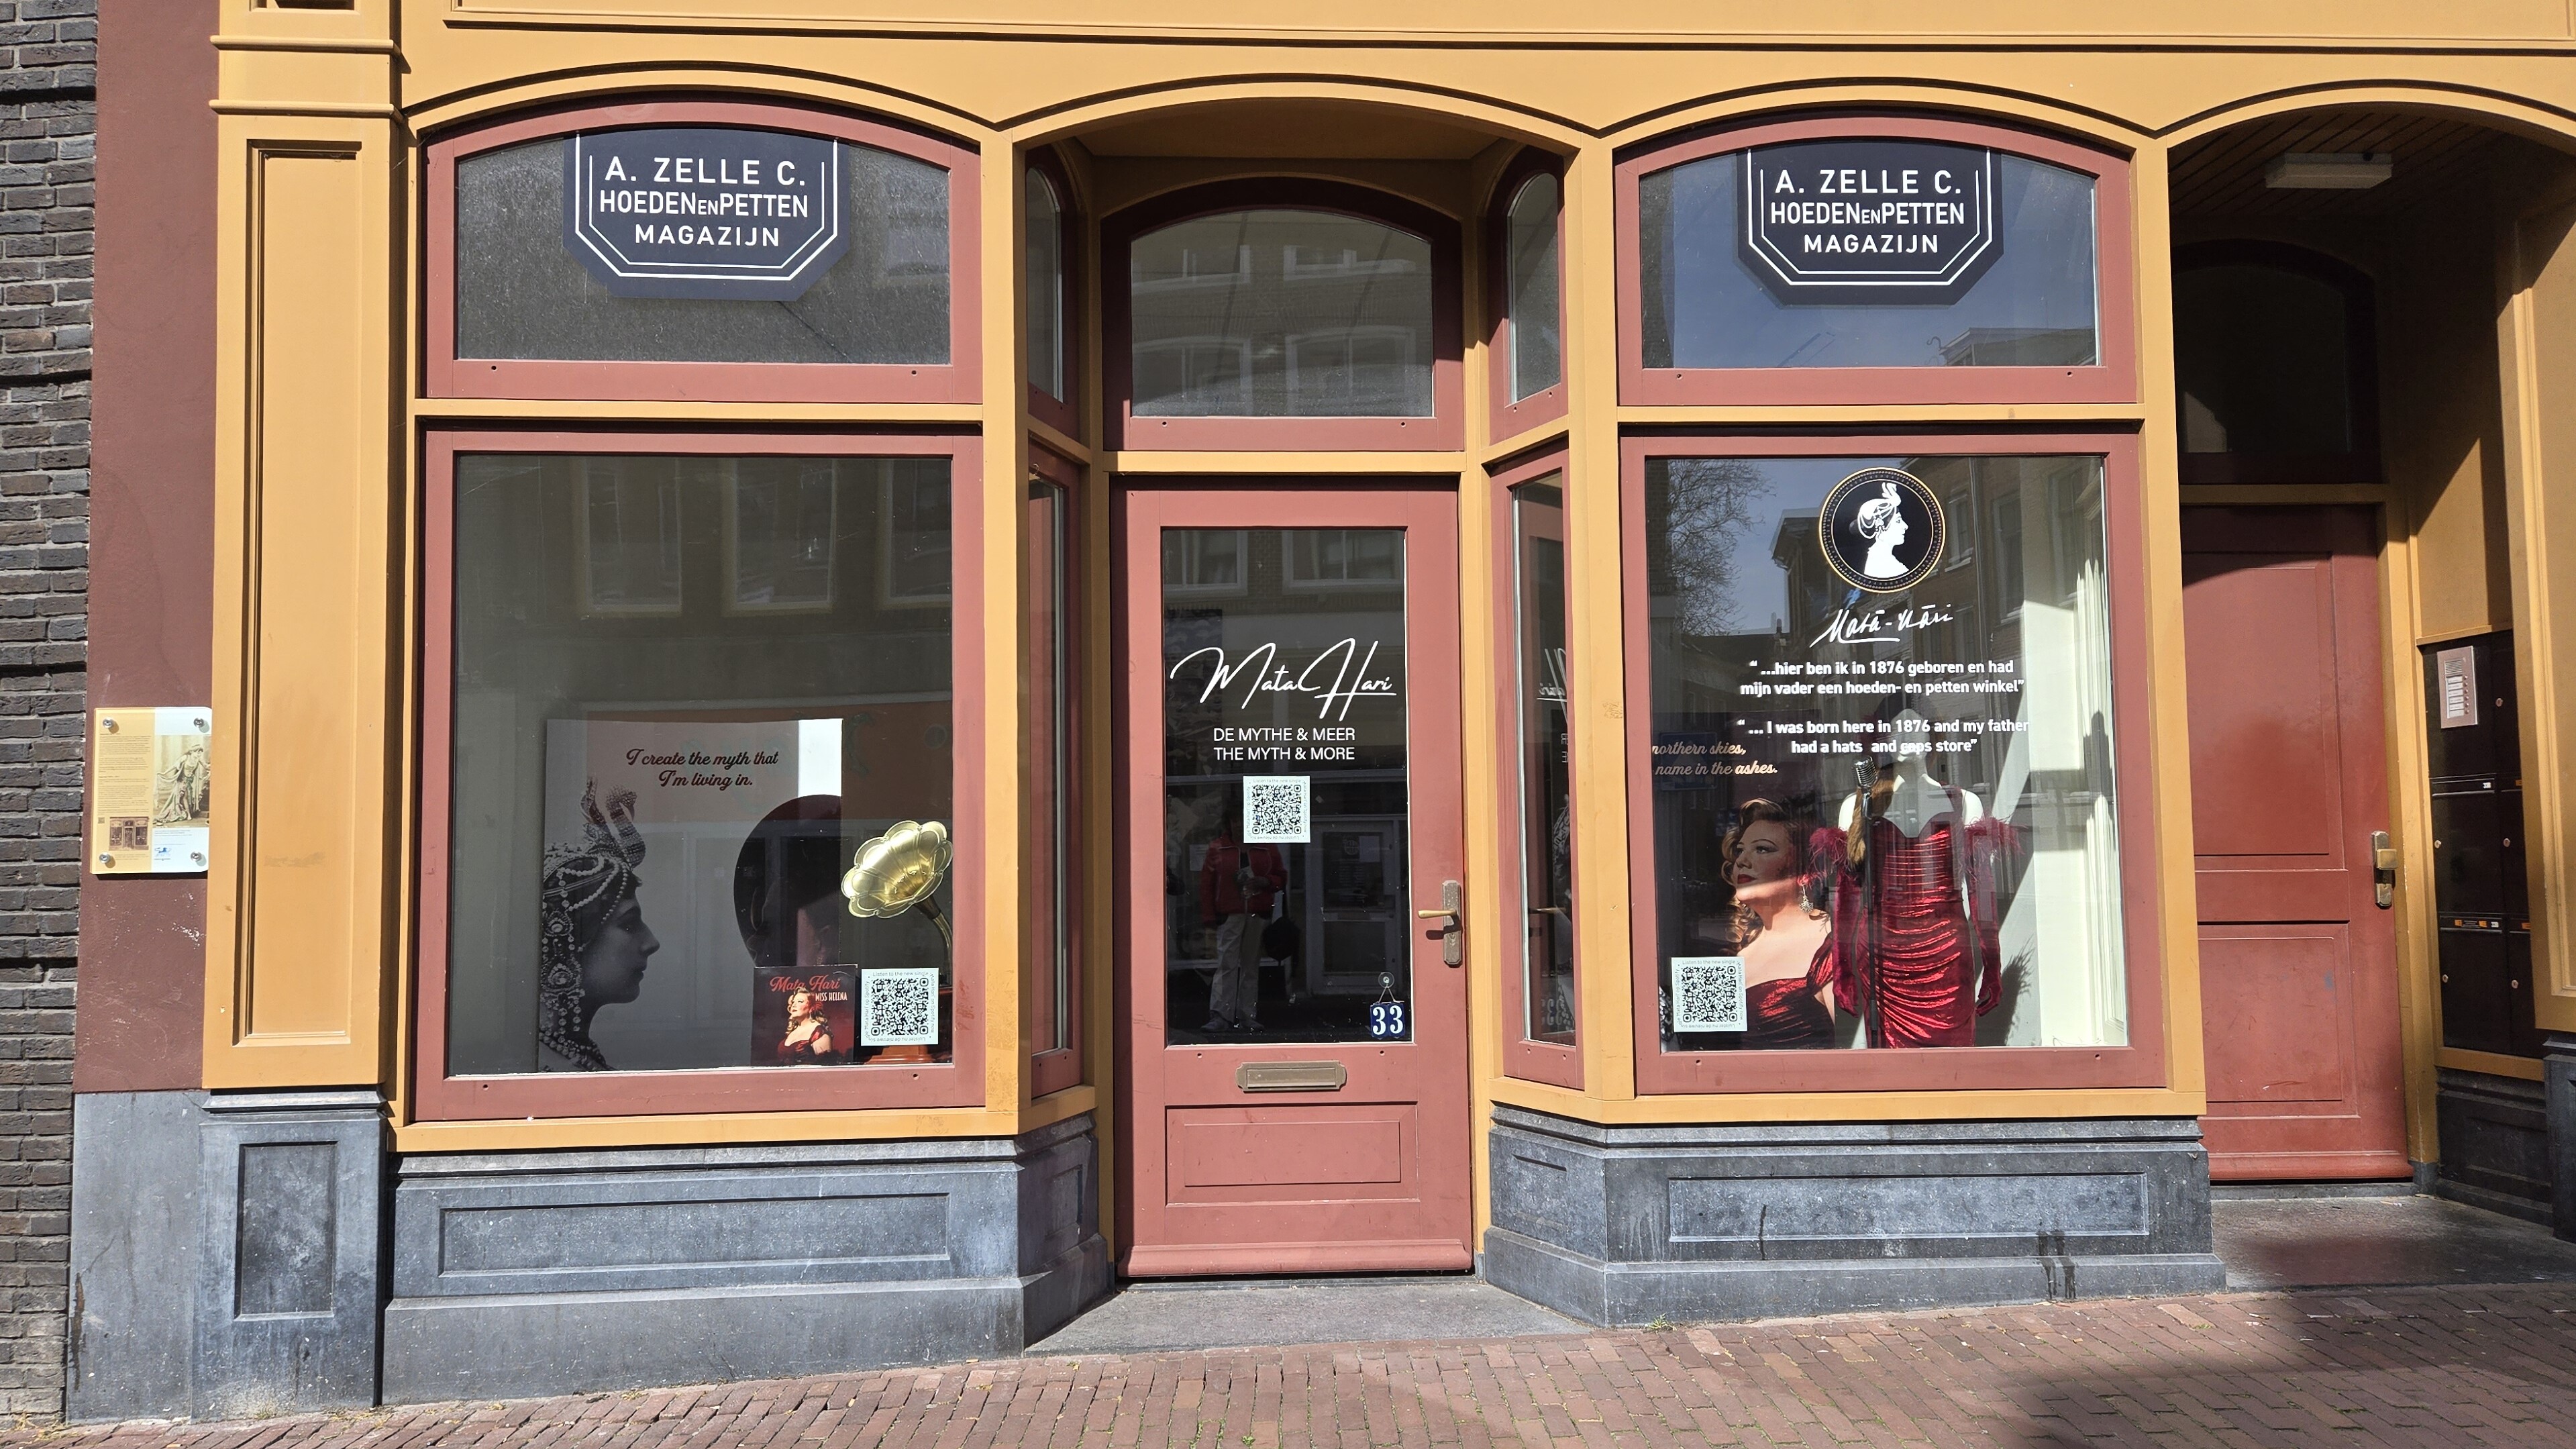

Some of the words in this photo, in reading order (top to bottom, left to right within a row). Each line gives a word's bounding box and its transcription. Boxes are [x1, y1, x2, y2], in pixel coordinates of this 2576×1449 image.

[605, 156, 637, 181] A.
[654, 157, 760, 185] ZELLE
[776, 160, 806, 187] C.
[1775, 169, 1804, 193] A.
[1820, 169, 1918, 193] ZELLE
[1935, 170, 1961, 194] C.
[635, 224, 780, 247] MAGAZIJN
[1804, 234, 1939, 254] MAGAZIJN
[1806, 662, 1832, 675] ben
[1835, 662, 1849, 675] ik
[1851, 662, 1865, 674] in
[1870, 661, 1904, 674] 1876
[1908, 660, 1964, 677] geboren
[1967, 662, 1984, 674] en
[1988, 660, 2014, 674] had
[1297, 638, 1397, 721] Hari
[1740, 681, 1771, 697] mijn
[1773, 681, 1814, 696] vader
[1817, 684, 1842, 695] een
[1846, 681, 1901, 695] hoeden-
[1905, 683, 1922, 694] en
[1925, 683, 1969, 696] petten
[1213, 728, 1235, 742] DE
[1239, 728, 1293, 742] MYTHE
[1296, 728, 1308, 741] &
[1312, 728, 1355, 741] MEER
[1775, 723, 1804, 734] was
[1807, 720, 1839, 734] born
[1843, 720, 1874, 734] here
[1877, 720, 1891, 733] in
[1896, 719, 1930, 733] 1876
[1934, 719, 1959, 732] and
[1963, 721, 1984, 736] my
[1987, 719, 2029, 732] father
[1213, 747, 1243, 761] THE
[1248, 747, 1291, 761] MYTH
[1295, 747, 1306, 760] &
[1310, 746, 1355, 760] MORE
[1652, 741, 1707, 755] northern
[1710, 741, 1747, 756] skies,
[1791, 740, 1817, 754] had
[1820, 743, 1829, 753] a
[1832, 739, 1863, 753] hats
[1871, 738, 1896, 752] and
[626, 748, 644, 766] I
[642, 752, 686, 765] create
[688, 751, 711, 765] the
[713, 751, 752, 770] myth
[753, 751, 779, 765] that
[1655, 764, 1692, 775] name
[1694, 763, 1709, 775] in
[1710, 761, 1733, 775] the
[1735, 760, 1778, 775] ashes.
[691, 772, 733, 791] living
[735, 773, 753, 786] in.
[770, 976, 807, 993] Mata
[809, 974, 841, 992] Hari
[815, 992, 827, 1001] MISS
[828, 991, 847, 1001] HELENA
[1372, 1005, 1404, 1036] 33
